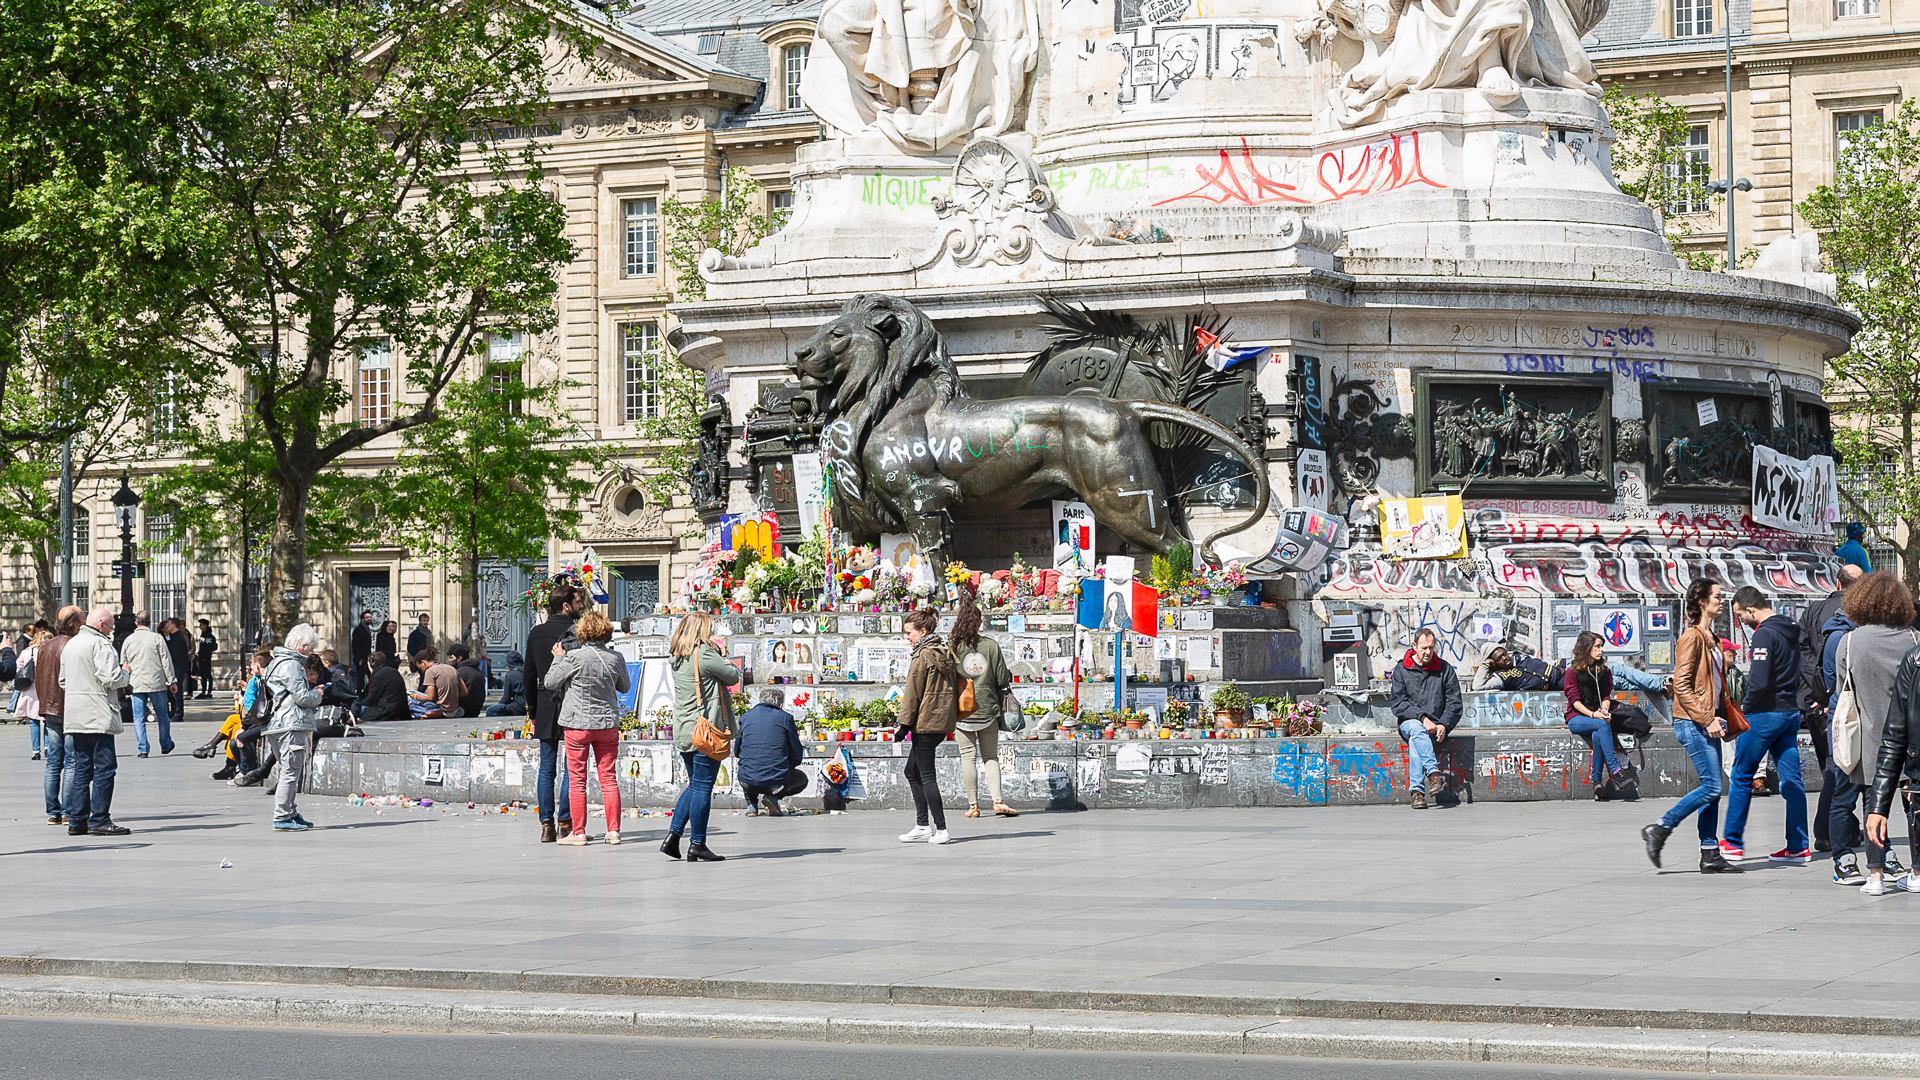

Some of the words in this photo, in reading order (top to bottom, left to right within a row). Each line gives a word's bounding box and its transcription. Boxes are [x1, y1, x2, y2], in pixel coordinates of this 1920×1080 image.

[1148, 0, 1184, 22] CHARLIE
[1137, 49, 1155, 58] DIEU
[862, 173, 942, 212] NIQUE
[1451, 325, 1476, 342] 20
[1486, 326, 1533, 343] JUIN
[1544, 327, 1581, 344] 1789
[1665, 331, 1678, 347] 14
[1685, 334, 1732, 353] JUILLET
[1735, 338, 1757, 356] 1789
[1059, 355, 1111, 386] 1789
[1353, 361, 1378, 370] MORT
[1384, 361, 1405, 369] POUR
[880, 436, 963, 469] AMOUR
[1308, 453, 1319, 462] PARIS
[1062, 507, 1085, 520] PARIS
[1690, 504, 1699, 513] BE
[1708, 505, 1735, 516] HELPER
[1031, 761, 1041, 771] LA
